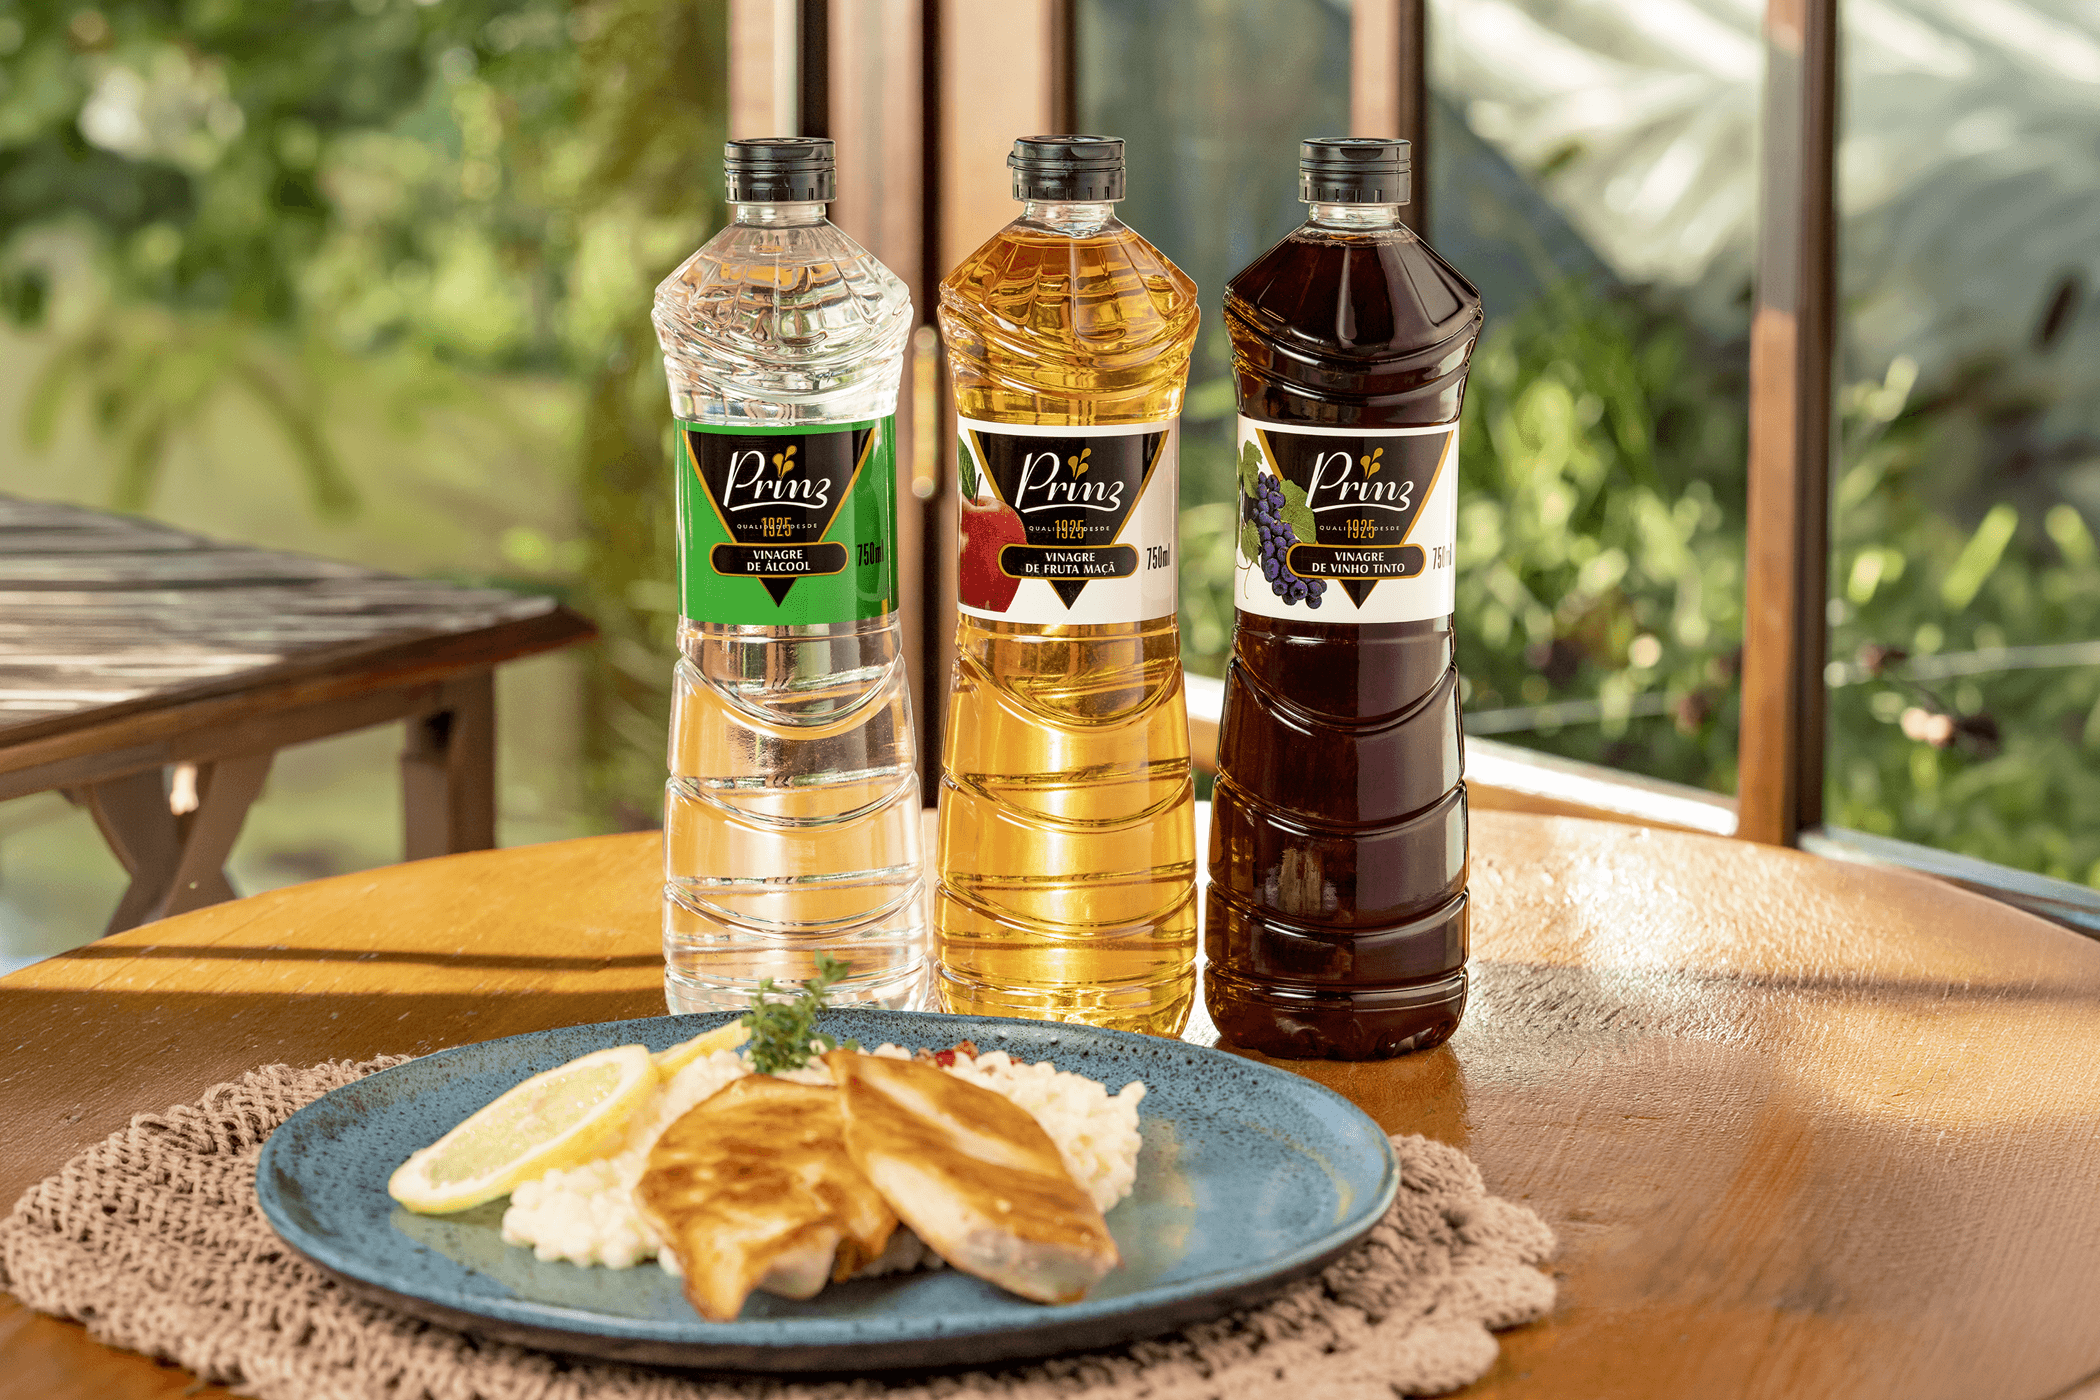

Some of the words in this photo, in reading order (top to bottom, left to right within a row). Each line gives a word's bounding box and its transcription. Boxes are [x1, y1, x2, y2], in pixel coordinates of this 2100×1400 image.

[723, 450, 831, 512] Prinz
[1015, 452, 1124, 513] Prinz
[1306, 451, 1414, 512] Prinz
[761, 517, 792, 537] 1925
[1055, 520, 1085, 539] 1925
[1346, 519, 1375, 539] 1925
[753, 550, 803, 560] VINAGRE
[857, 538, 884, 567] 750ml
[1045, 552, 1095, 562] VINAGRE
[1146, 543, 1170, 570] 750ml
[1335, 552, 1384, 562] VINAGRE
[747, 562, 761, 572] DE
[765, 559, 811, 571] ÁLCOOL
[1026, 564, 1040, 573] DE
[1044, 564, 1079, 574] FRUTA
[1083, 562, 1115, 575] MAÇÃ
[1312, 563, 1327, 573] DE
[1331, 564, 1369, 573] VINHO
[1373, 563, 1405, 573] TINTO
